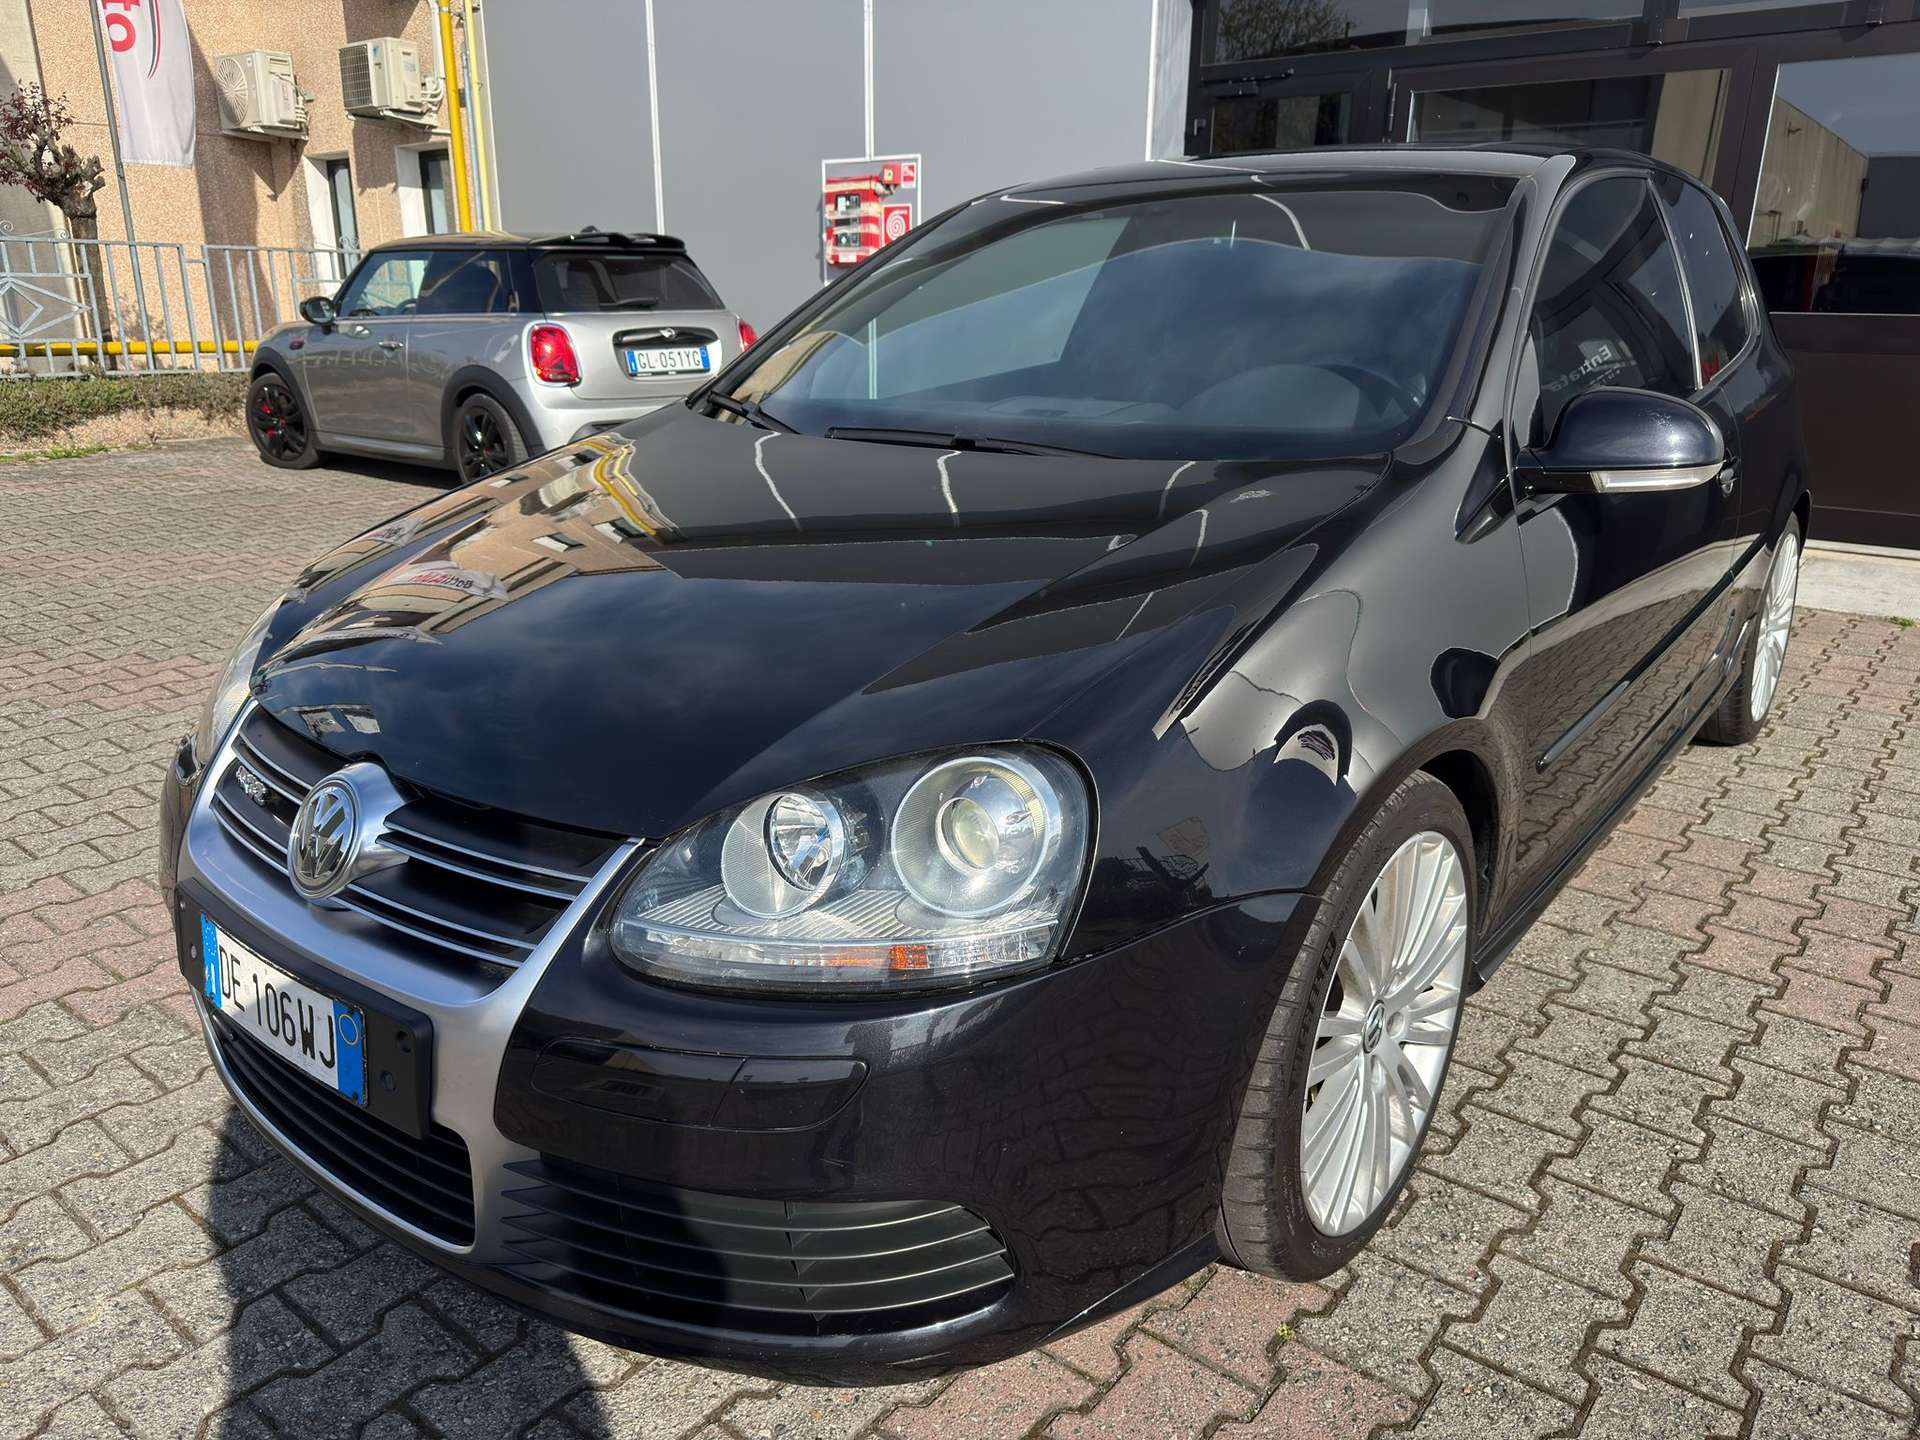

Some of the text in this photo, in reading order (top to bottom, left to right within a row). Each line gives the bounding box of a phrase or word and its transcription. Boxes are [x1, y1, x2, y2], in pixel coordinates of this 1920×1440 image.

[637, 352, 656, 369] GL
[660, 350, 701, 368] 051YG
[218, 944, 246, 1012] DE
[252, 973, 336, 1069] 106WJ
